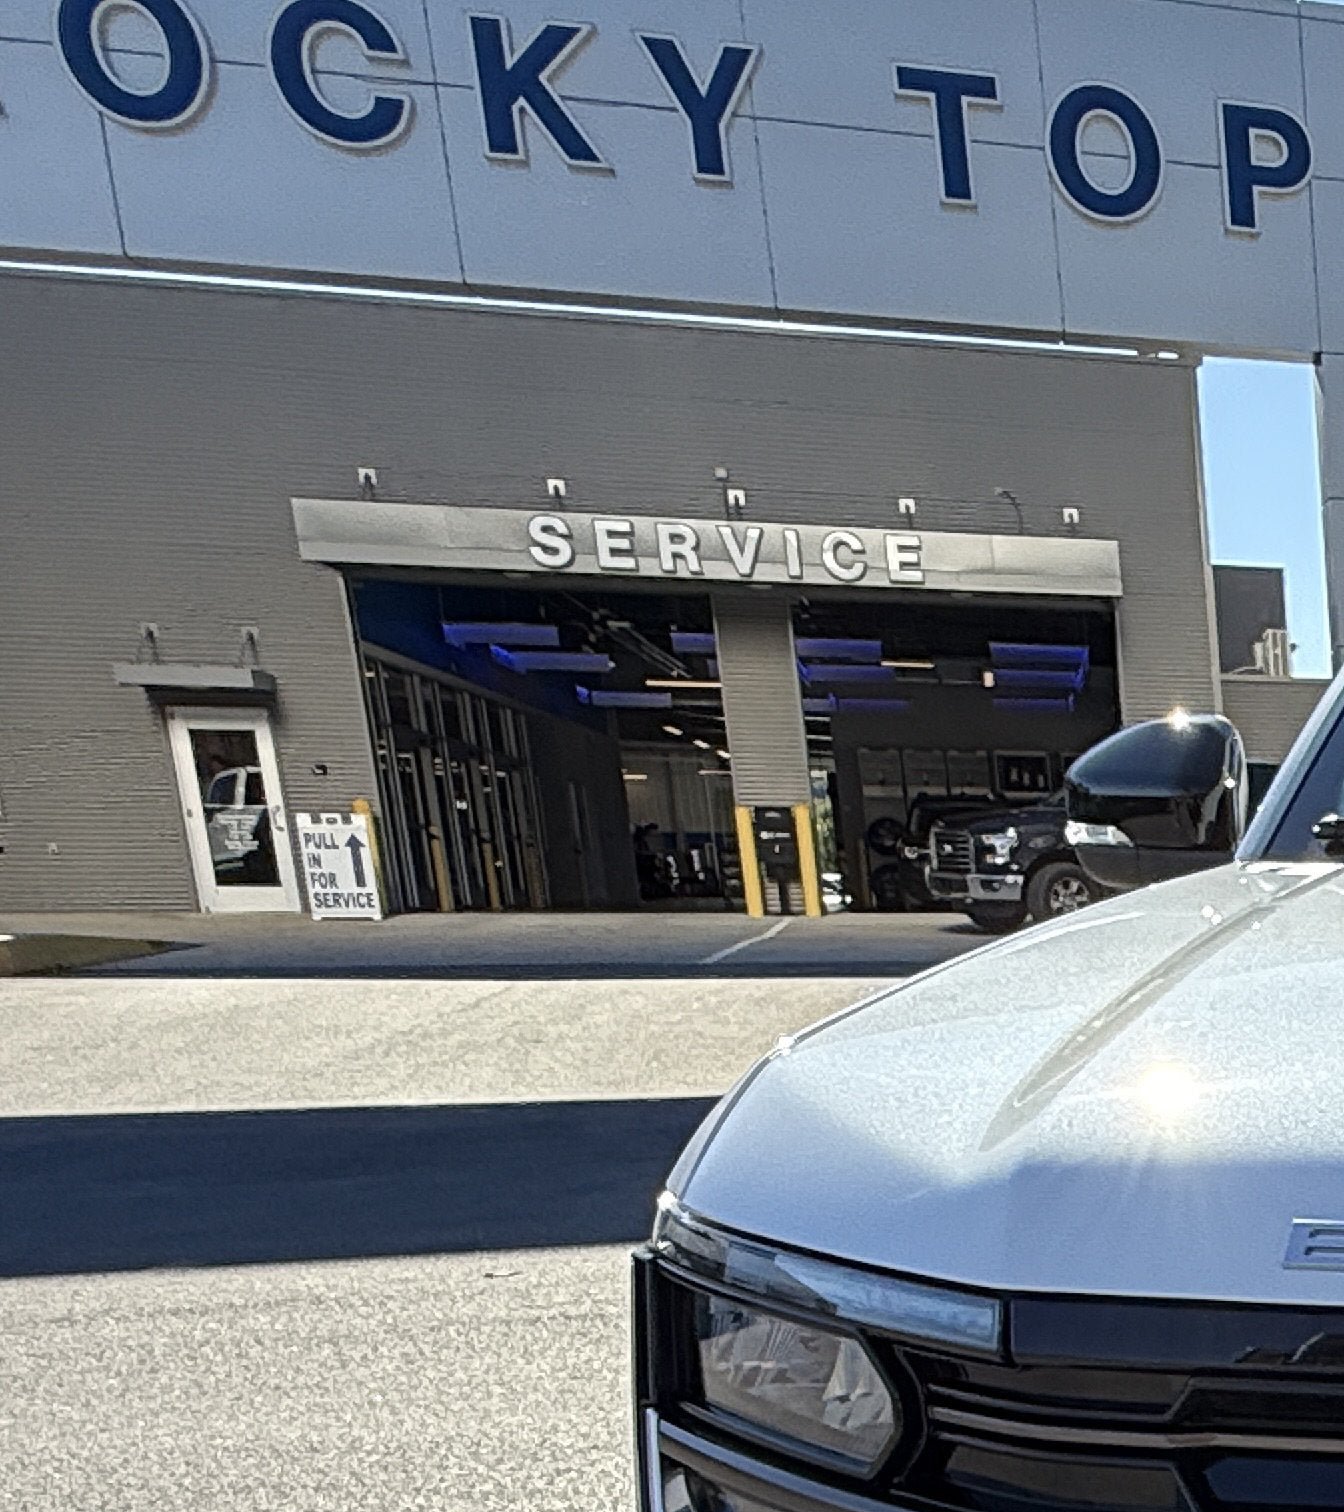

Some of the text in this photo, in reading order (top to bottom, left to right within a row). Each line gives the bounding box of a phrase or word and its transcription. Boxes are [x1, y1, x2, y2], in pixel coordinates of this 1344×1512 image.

[0, 0, 1314, 236] OCKY TOP
[528, 515, 925, 584] SERVICE
[303, 832, 340, 850] PULL
[307, 852, 323, 869] IN
[310, 872, 340, 890] FOR
[313, 892, 376, 909] SERVICE
